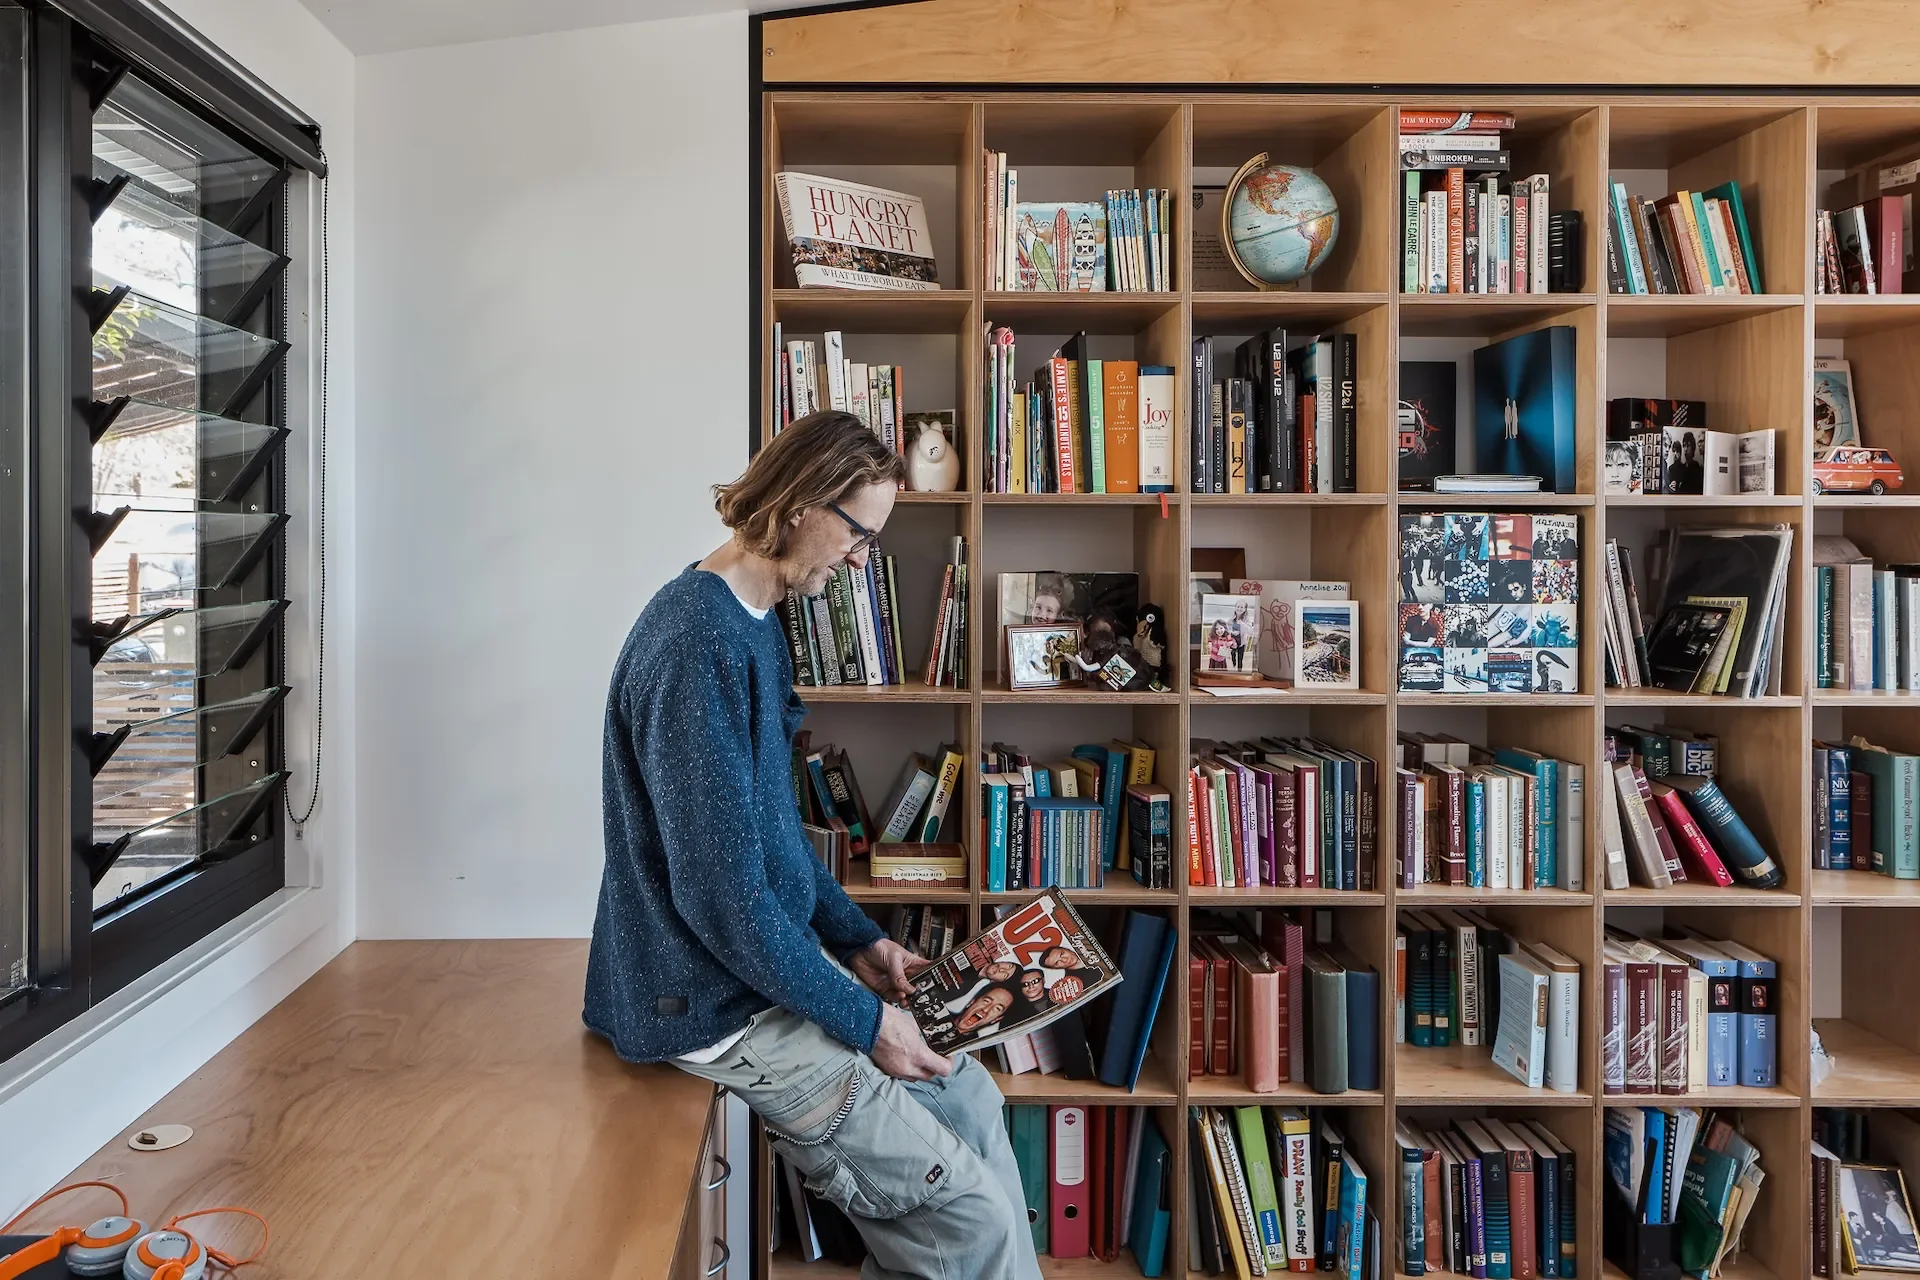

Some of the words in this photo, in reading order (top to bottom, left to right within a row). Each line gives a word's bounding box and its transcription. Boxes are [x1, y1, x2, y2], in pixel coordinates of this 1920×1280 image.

[1401, 117, 1417, 127] TIM
[1418, 116, 1452, 127] WINTON
[1451, 172, 1462, 197] HARPER
[807, 186, 913, 228] HUNGRY
[1407, 195, 1418, 218] JOHN
[1451, 199, 1462, 209] LEE
[1468, 188, 1476, 207] FAIR
[1437, 196, 1445, 224] JOHN
[1451, 217, 1462, 226] GO
[1468, 207, 1476, 232] GAME
[811, 211, 918, 253] PLANET
[1409, 219, 1417, 227] LE
[1451, 228, 1462, 240] SET
[1515, 206, 1526, 252] SCHINDLER'S
[1407, 227, 1420, 255] CARRÉ
[1621, 206, 1635, 246] Reformation
[1629, 246, 1641, 274] Thought
[1437, 238, 1446, 272] CARRÉ
[1451, 247, 1462, 285] WATCHMAN
[1515, 256, 1526, 273] ARK
[1610, 253, 1618, 273] READER
[821, 268, 851, 282] WHAT
[851, 271, 870, 283] THE
[870, 274, 904, 288] WORLD
[904, 279, 927, 290] EATS
[1055, 363, 1068, 403] JAMIE'S
[1070, 367, 1079, 389] tana
[1319, 376, 1333, 391] U2
[883, 402, 892, 423] grow
[1056, 405, 1069, 422] 15
[1069, 391, 1082, 436] ramsay's
[1319, 391, 1333, 423] SHOW
[1091, 416, 1101, 430] 5
[1059, 421, 1070, 450] MINUTE
[1092, 433, 1102, 471] INGREDIENTS
[1061, 452, 1072, 477] MEALS
[874, 549, 886, 580] NATIVE
[853, 567, 862, 593] GARDEN
[1299, 583, 1331, 592] Annelise
[1333, 584, 1347, 592] 2011
[786, 590, 797, 620] NATIVE
[832, 582, 843, 608] Plants
[878, 582, 890, 618] GARDEN
[1821, 610, 1830, 628] Ways
[942, 762, 956, 784] God
[1544, 764, 1552, 788] Revelation
[1904, 759, 1913, 775] Greek
[793, 775, 802, 807] DICTIONARY
[1452, 777, 1460, 790] The
[1832, 780, 1850, 788] NIV
[1904, 775, 1913, 799] Grammar
[936, 790, 945, 805] me
[1451, 791, 1461, 825] Spreading
[1902, 799, 1913, 819] Beyond
[892, 800, 911, 830] HEART
[899, 803, 918, 833] HAPPY
[994, 829, 1003, 848] Group
[1017, 833, 1023, 844] ON
[1190, 819, 1198, 845] TRUTH
[1518, 827, 1523, 836] OF
[1904, 824, 1913, 841] Basics
[1695, 836, 1708, 854] PEOPLE
[1191, 848, 1200, 870] Milne
[1002, 902, 1063, 966] U2
[1463, 949, 1476, 984] APPLICATION
[1464, 984, 1477, 1022] COMMENTARY
[1720, 1016, 1728, 1038] LUKE
[1757, 1018, 1766, 1039] LUKE
[1292, 1139, 1305, 1176] DRAW
[1452, 1174, 1460, 1185] the
[1294, 1179, 1306, 1208] Really
[1410, 1196, 1416, 1204] OF
[1451, 1185, 1460, 1215] Beginning
[1519, 1175, 1528, 1228] DEUTERONOMY
[1295, 1208, 1306, 1228] Cool
[1355, 1203, 1363, 1221] Bible
[1265, 1212, 1276, 1244] Beautone
[1354, 1222, 1362, 1246] Activity
[1295, 1228, 1308, 1256] Stuff
[1353, 1247, 1361, 1264] Book
